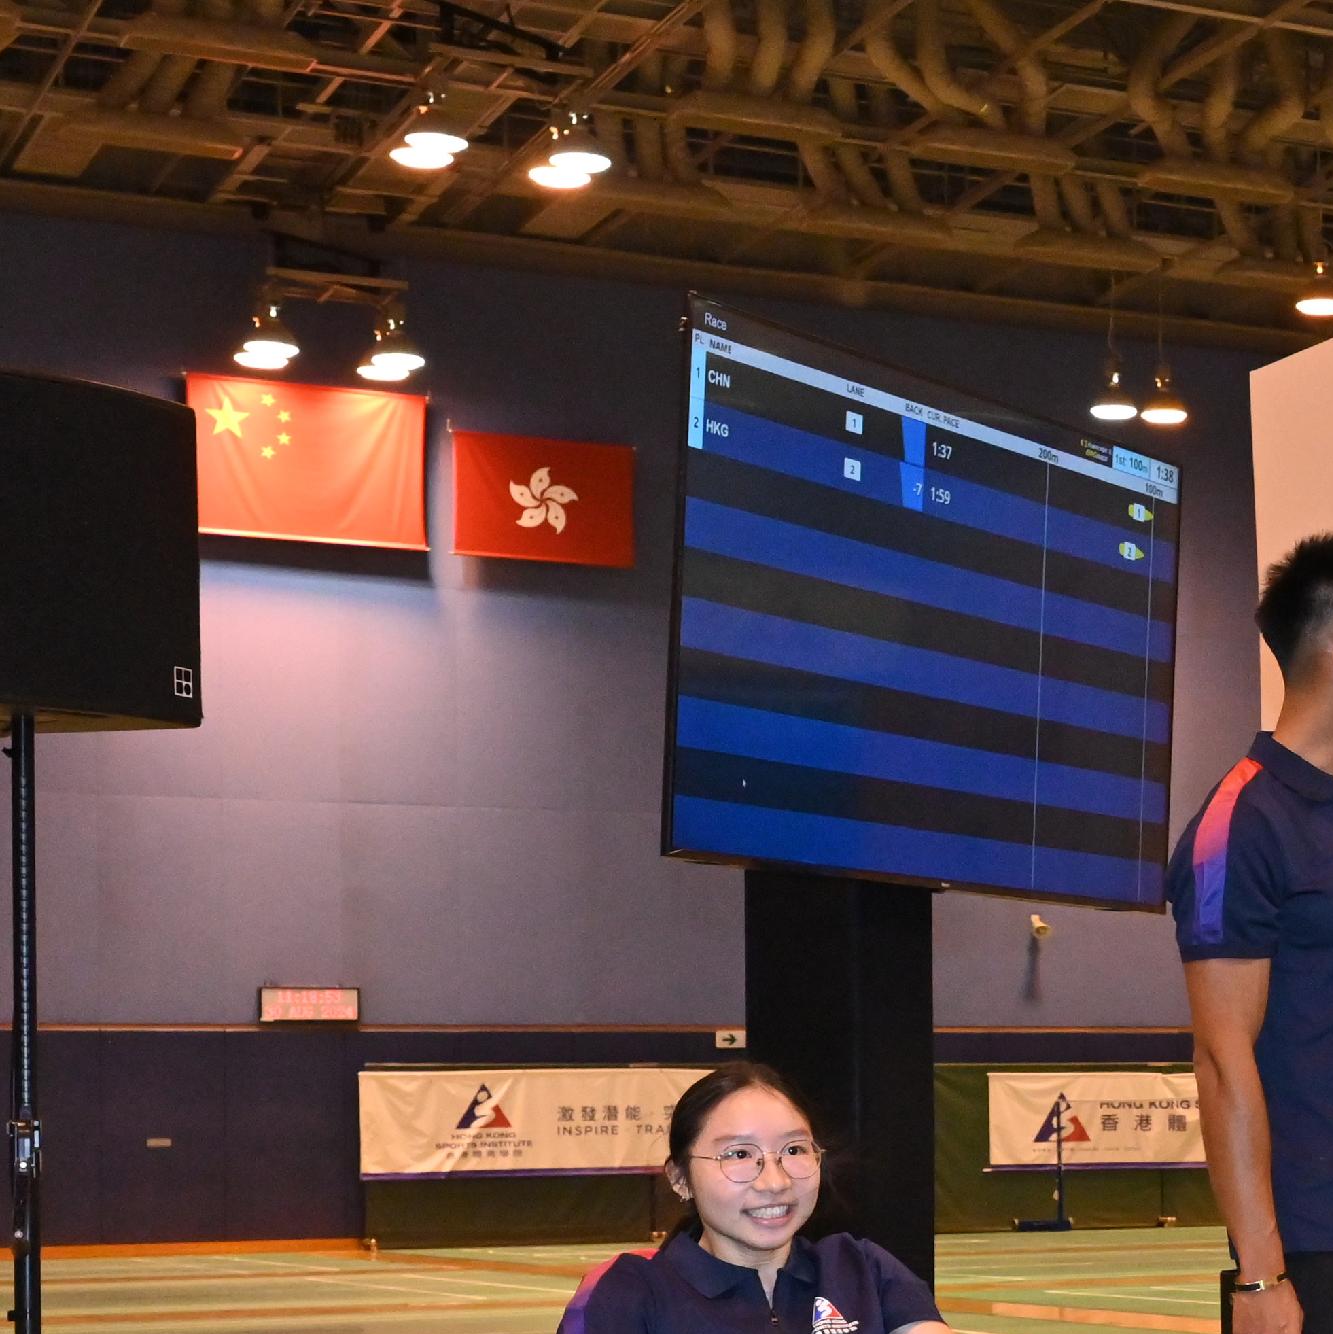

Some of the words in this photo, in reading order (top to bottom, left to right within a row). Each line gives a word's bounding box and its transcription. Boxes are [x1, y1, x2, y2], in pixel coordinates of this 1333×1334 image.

[705, 313, 727, 330] Race
[846, 383, 865, 397] LANE
[905, 403, 924, 417] BACK
[708, 369, 731, 388] CHN
[932, 442, 952, 460] 1:37
[694, 417, 699, 428] 2
[706, 419, 729, 437] HKG
[913, 483, 923, 496] -7
[930, 487, 950, 505] 1:59
[1156, 465, 1174, 483] 1:38
[485, 1130, 517, 1140] KONG
[557, 1125, 619, 1136] INSPIRE
[480, 1139, 533, 1149] INSTITUTE
